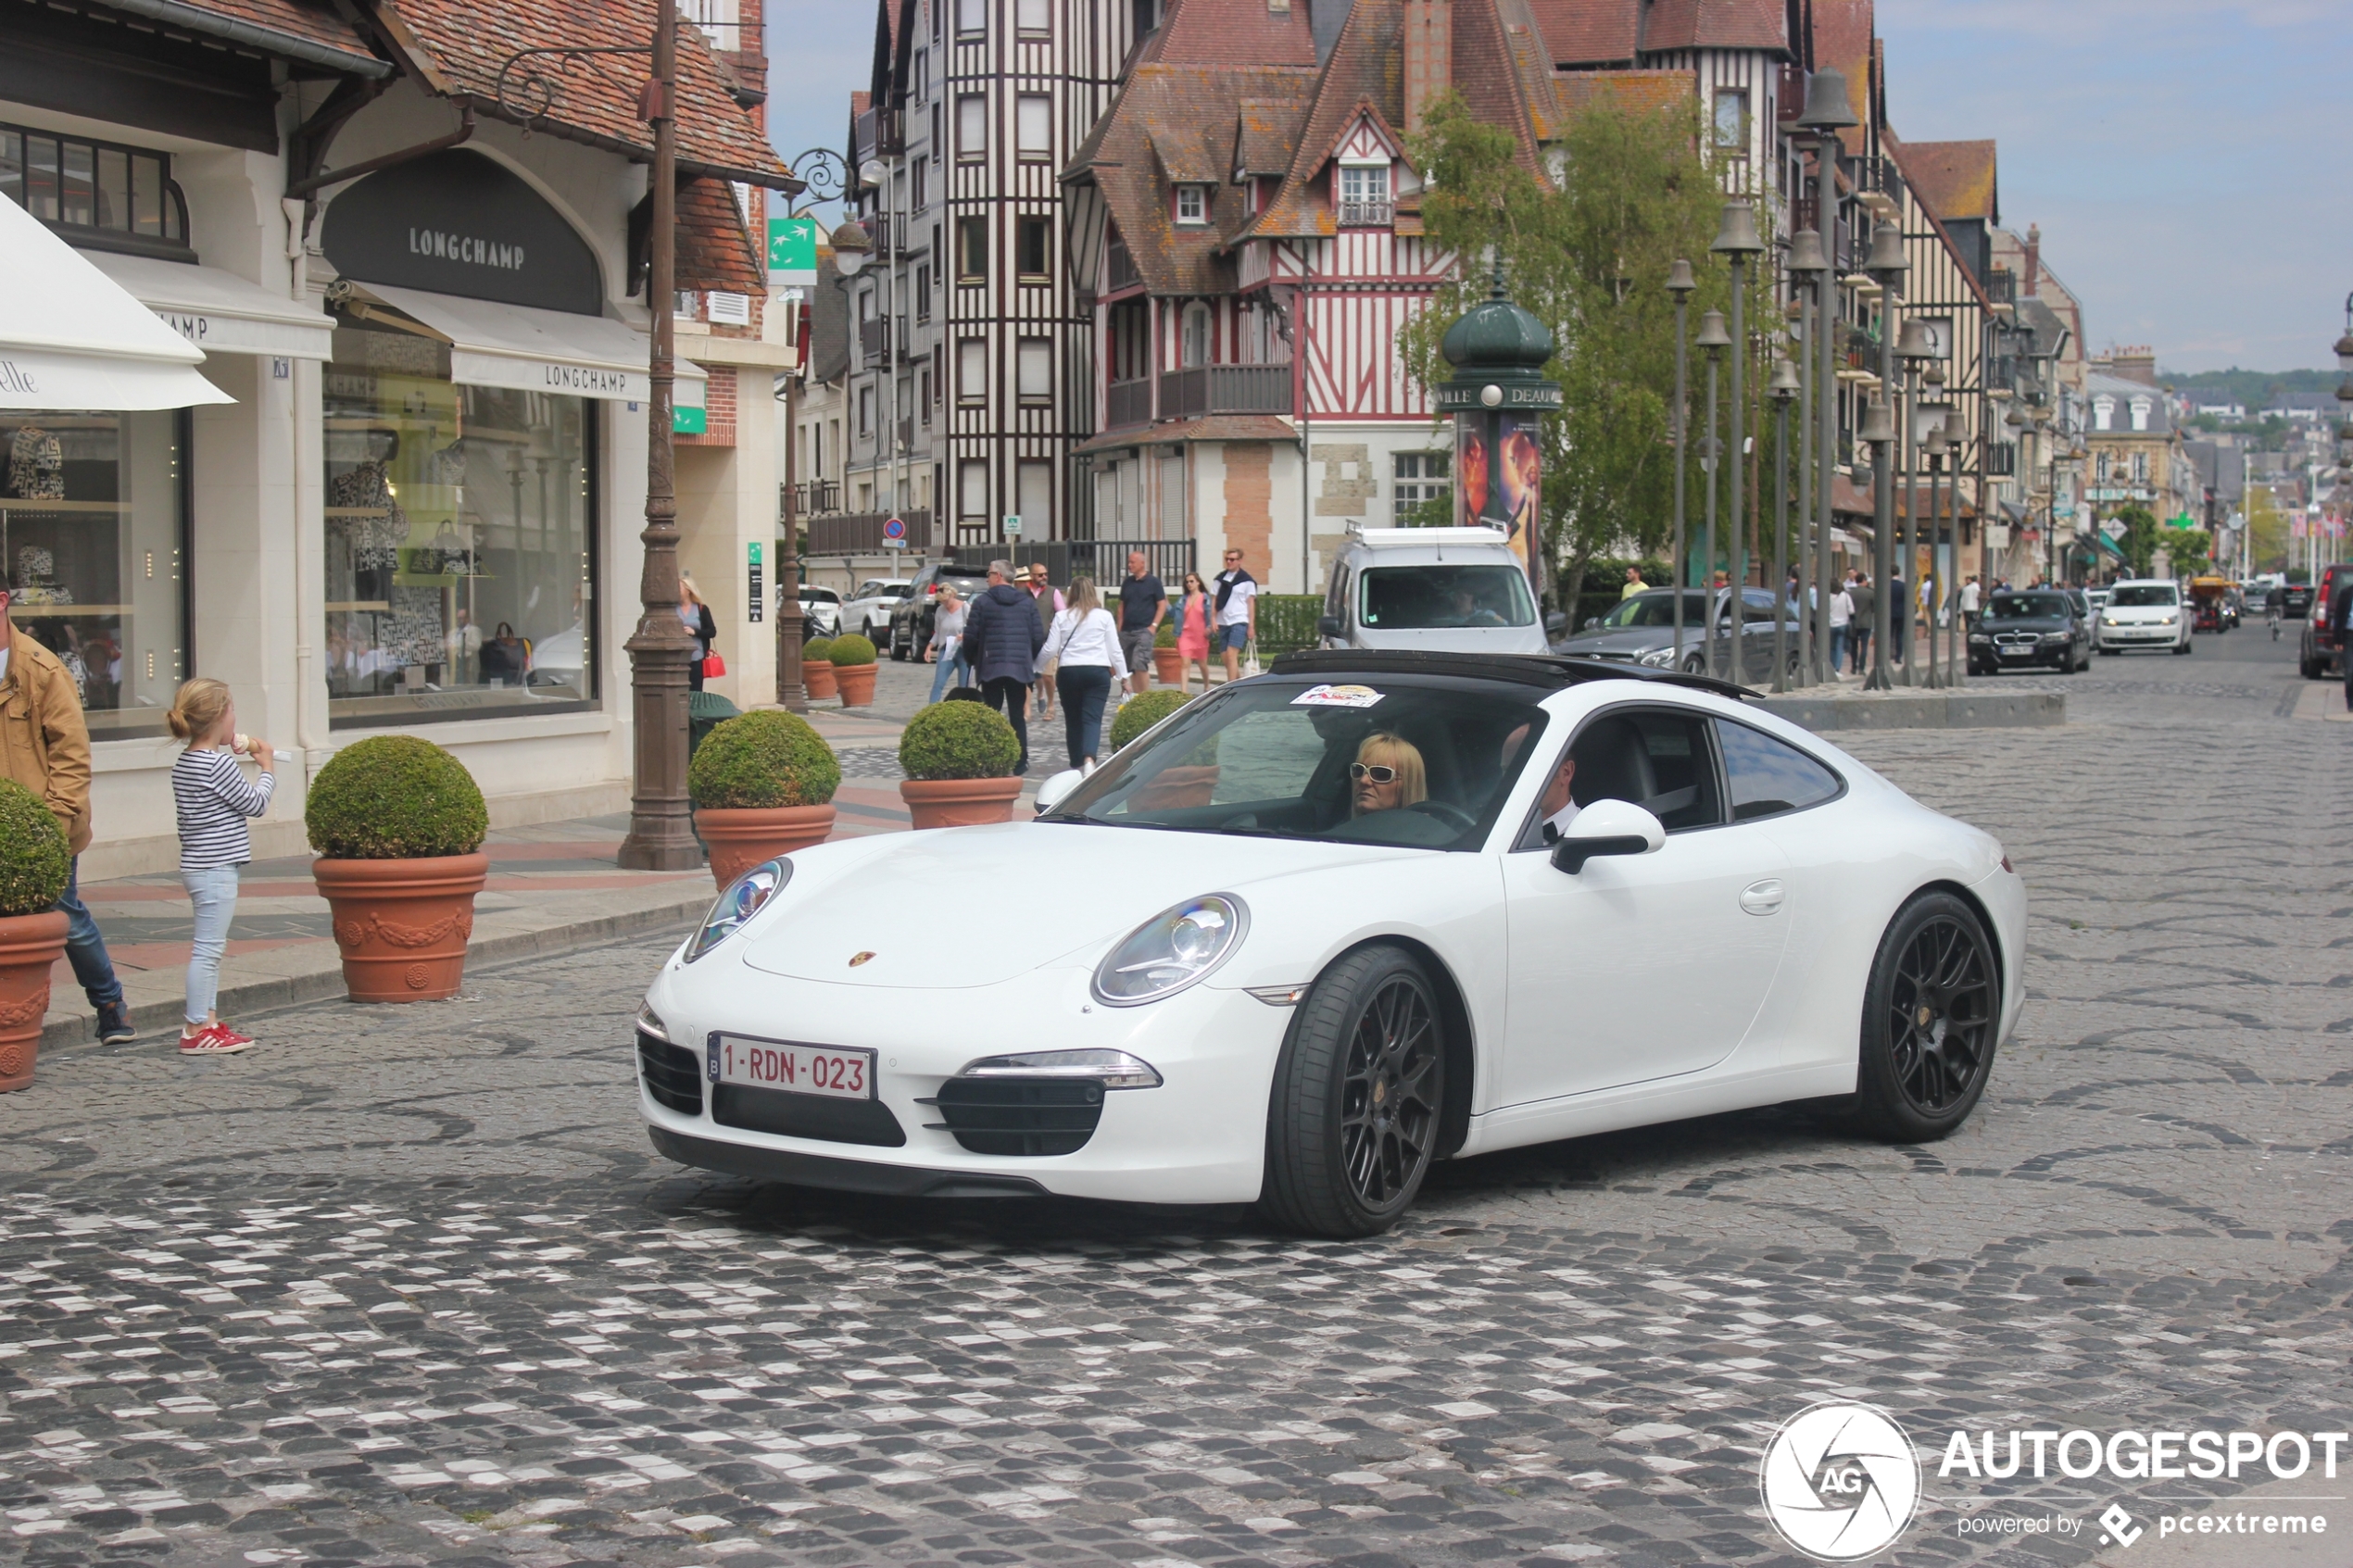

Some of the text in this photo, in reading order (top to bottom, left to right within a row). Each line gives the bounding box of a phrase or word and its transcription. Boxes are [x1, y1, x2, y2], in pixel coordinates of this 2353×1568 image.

[409, 227, 524, 270] LONGCHAMP
[546, 365, 626, 392] LONGCHAMP
[710, 1060, 719, 1074] B
[724, 1044, 863, 1092] 1-RDN-023
